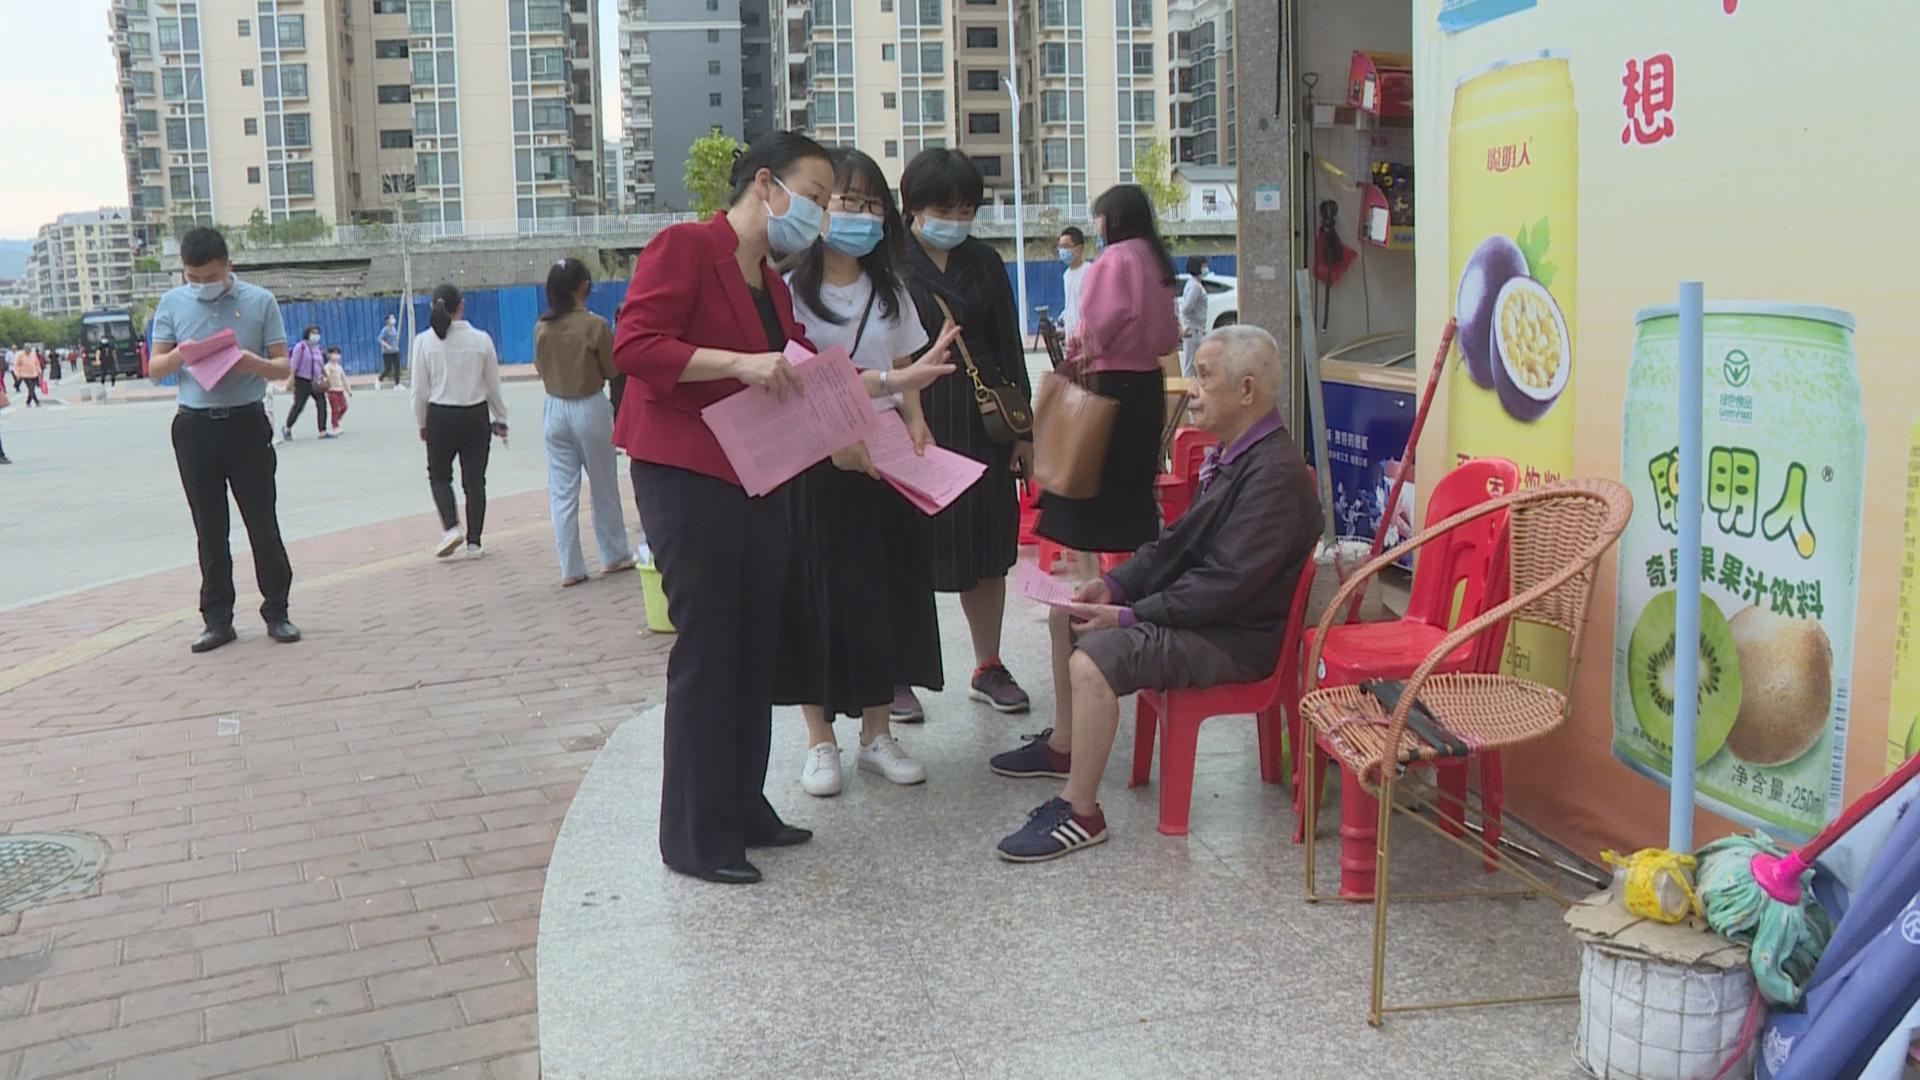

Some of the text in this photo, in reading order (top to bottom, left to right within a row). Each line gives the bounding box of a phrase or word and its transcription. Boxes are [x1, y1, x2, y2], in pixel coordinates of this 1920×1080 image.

[1621, 53, 1675, 145] 想
[1487, 141, 1531, 172] 聪明人
